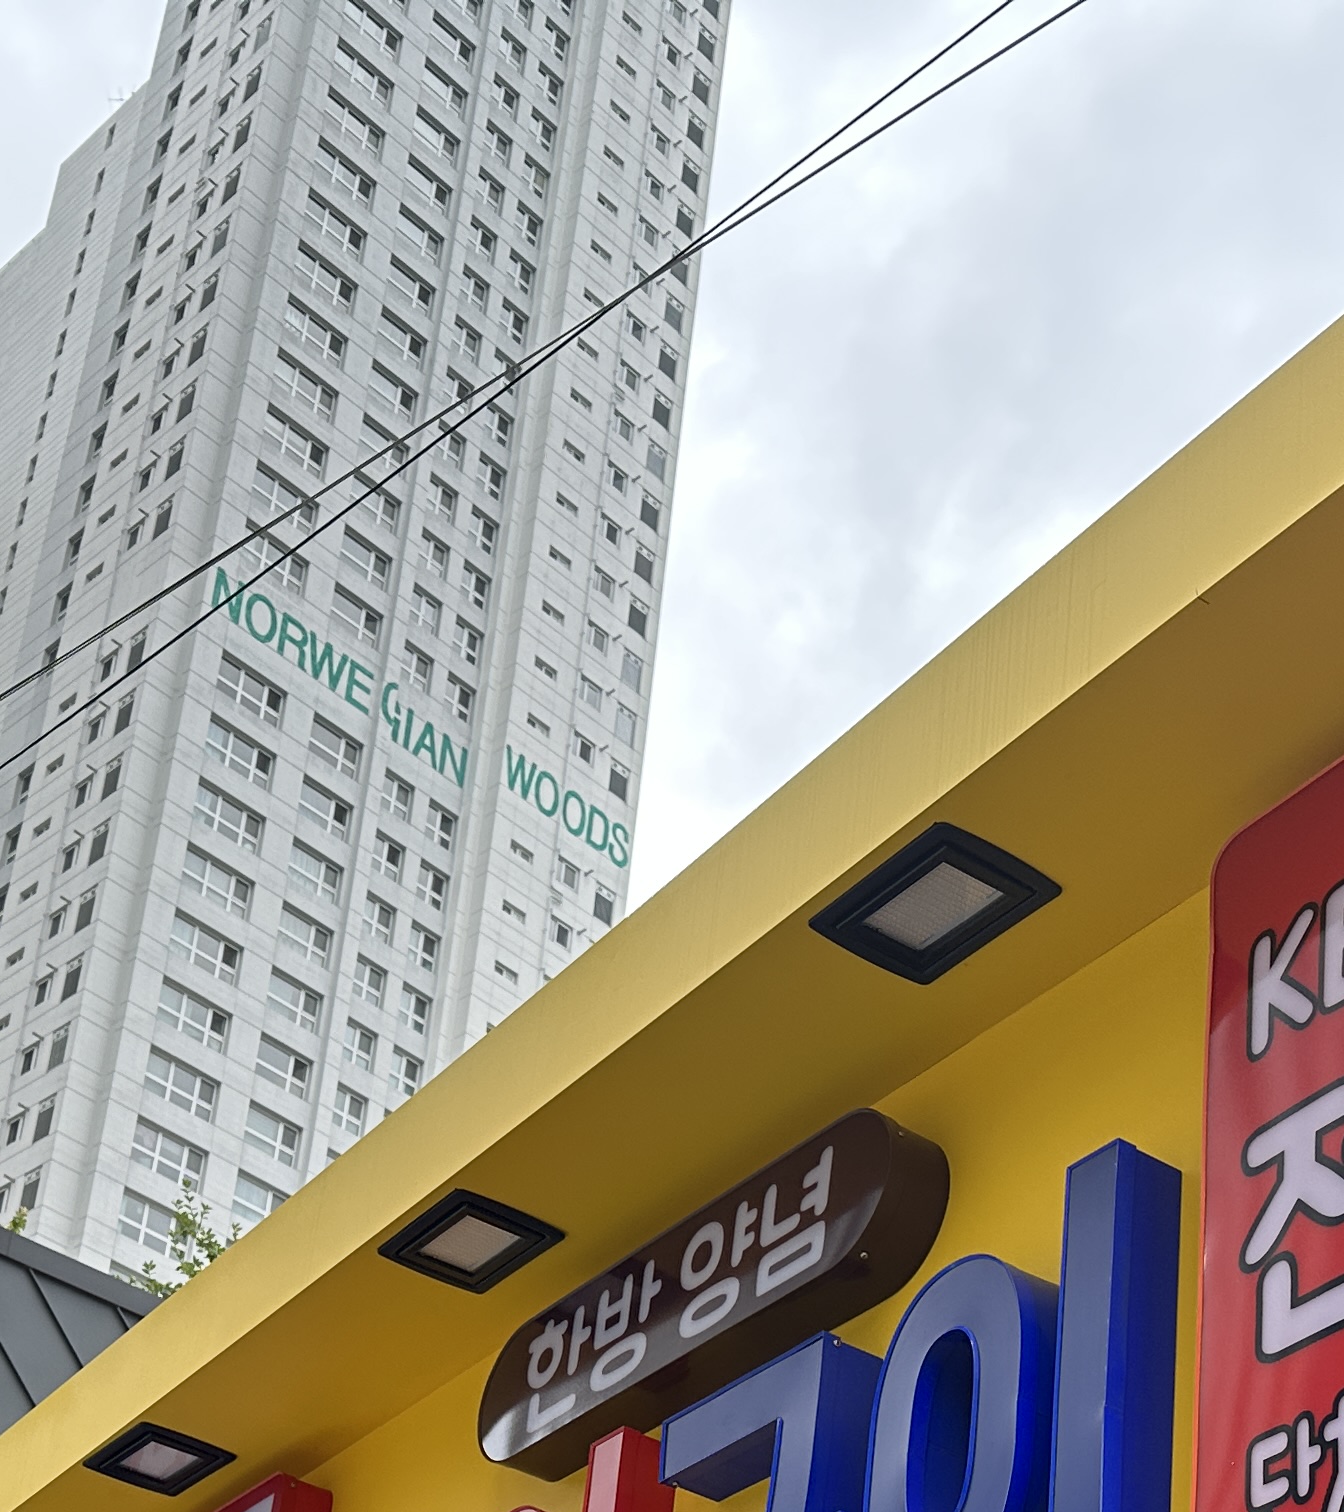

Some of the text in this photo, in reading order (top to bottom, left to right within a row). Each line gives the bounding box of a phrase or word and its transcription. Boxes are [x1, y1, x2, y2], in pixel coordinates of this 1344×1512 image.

[505, 743, 631, 869] WOODS
[524, 1142, 836, 1424] 한방 양념
